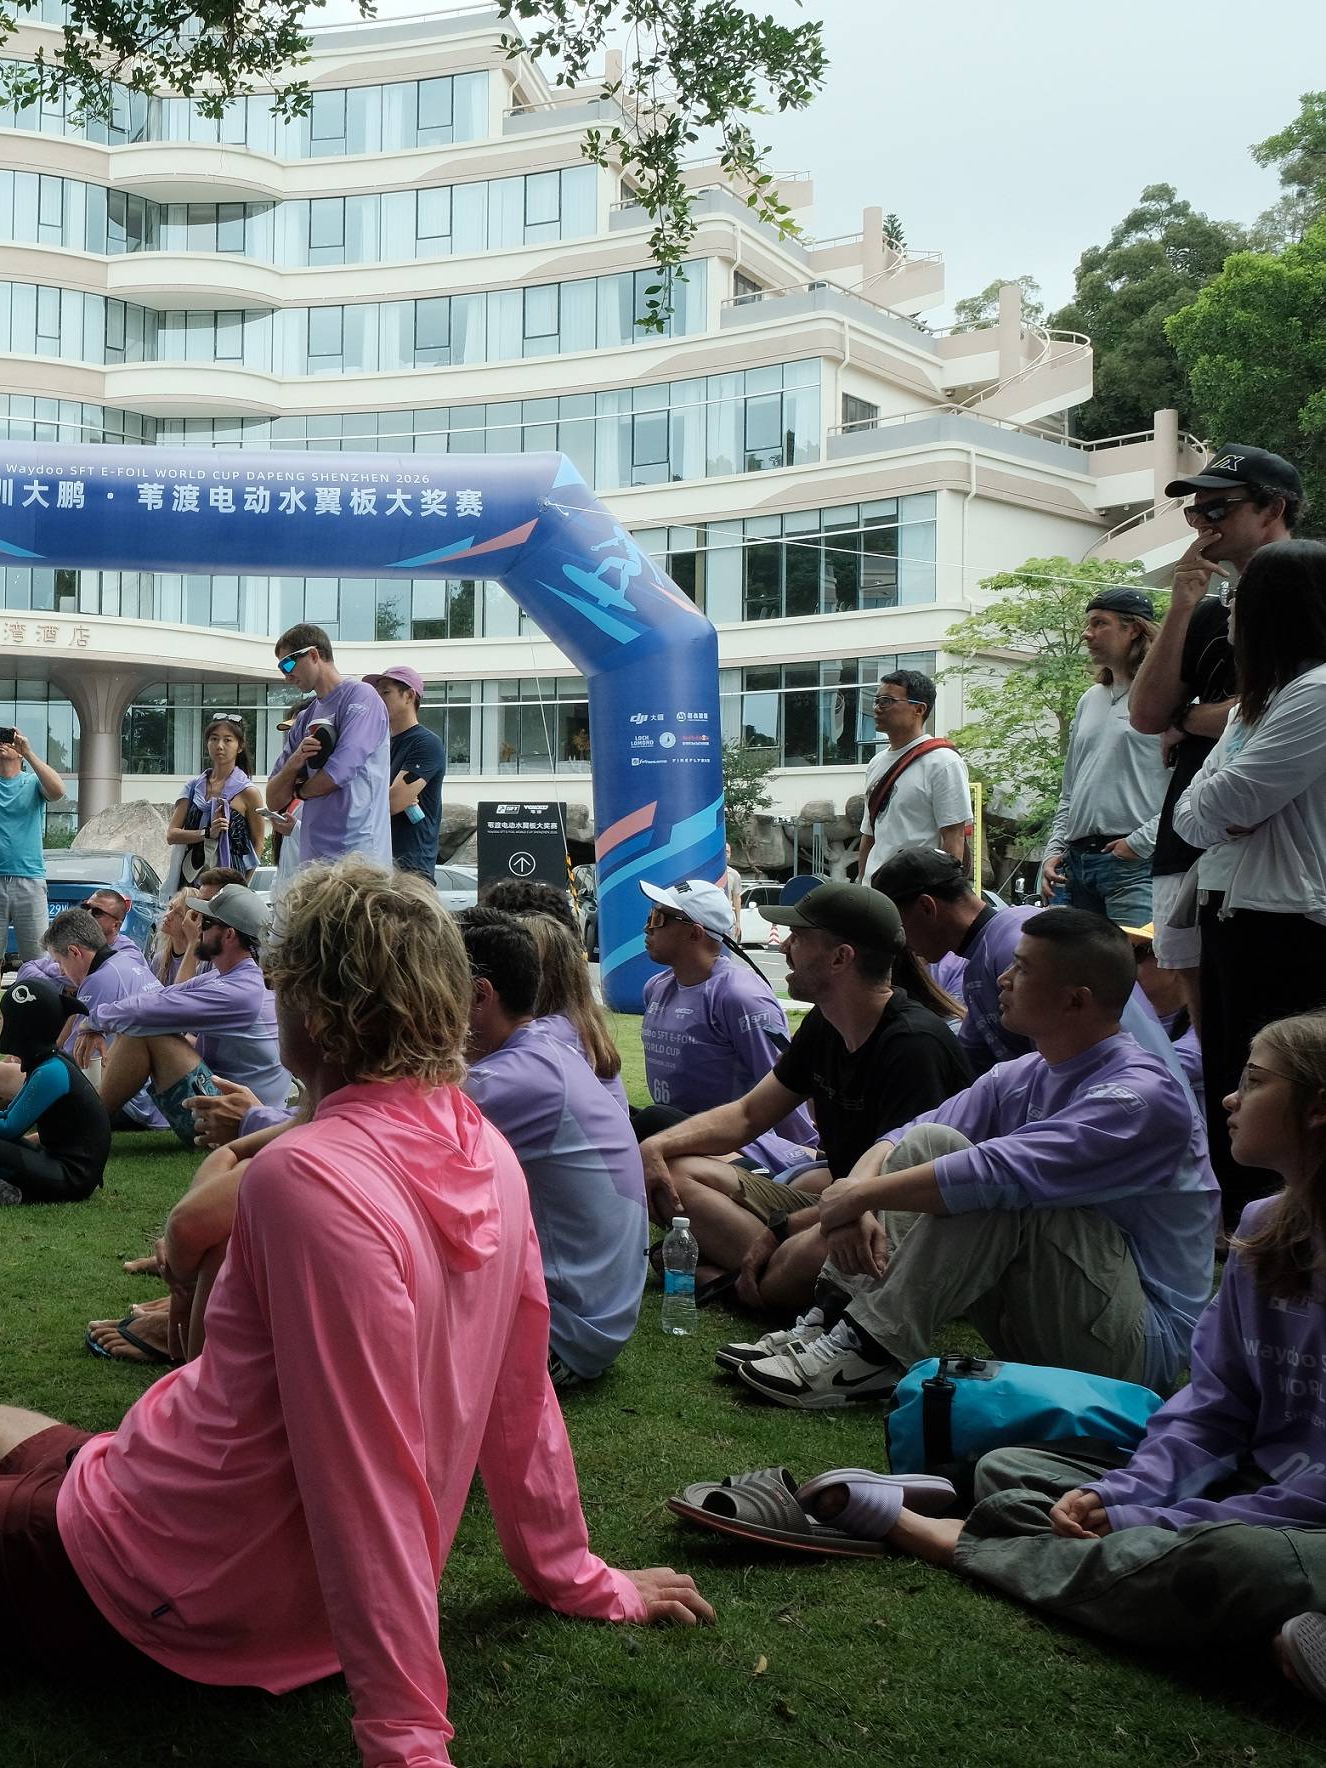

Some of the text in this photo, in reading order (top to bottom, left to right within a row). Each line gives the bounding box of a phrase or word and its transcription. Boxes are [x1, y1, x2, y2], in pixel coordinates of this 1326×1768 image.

[6, 463, 430, 484] Waydoo SFT E-FOIL WORLD CUP DAPENG SHENZHEN 2026
[653, 1078, 670, 1104] 66
